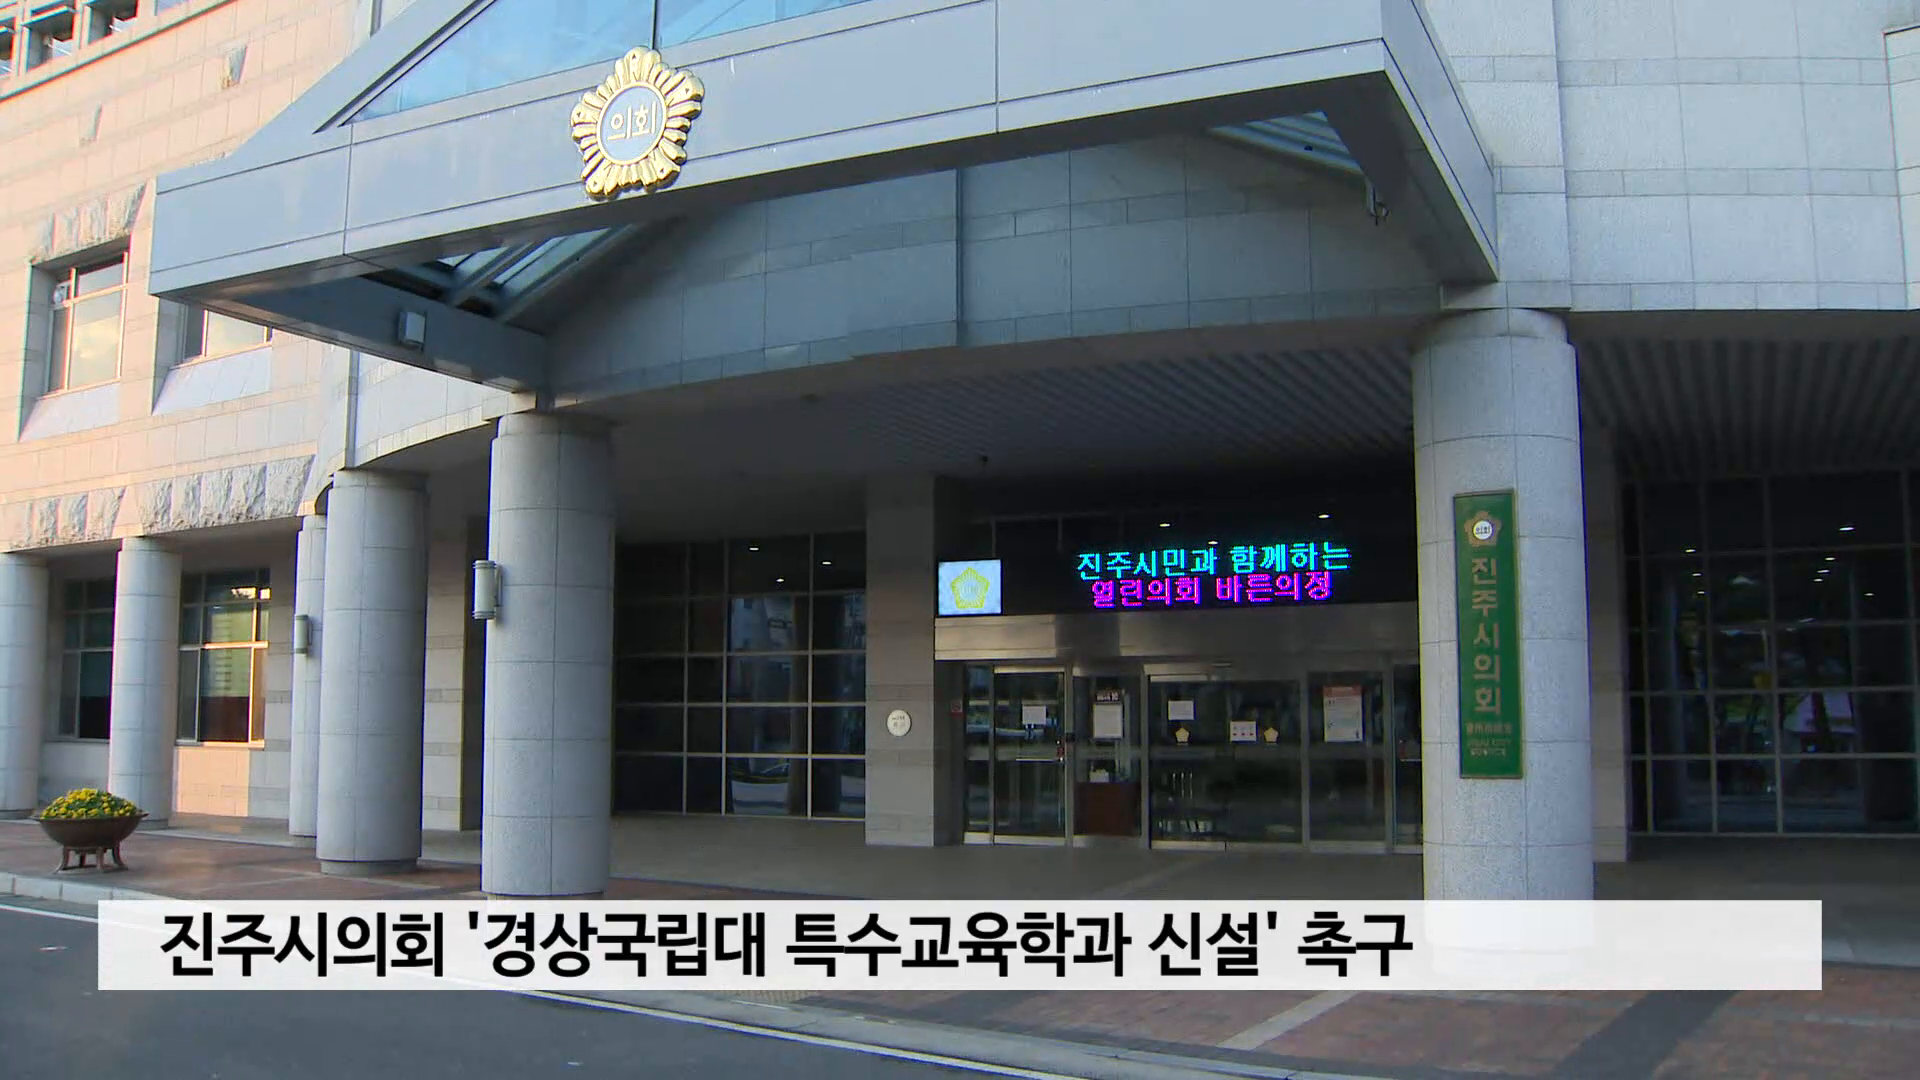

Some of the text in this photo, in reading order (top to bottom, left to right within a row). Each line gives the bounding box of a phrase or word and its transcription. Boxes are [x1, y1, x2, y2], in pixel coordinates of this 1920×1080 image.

[607, 101, 656, 140] 의회
[1077, 541, 1350, 580] 진주시민과 함께하는
[1091, 570, 1332, 608] 열린의회 바른의정
[1471, 557, 1501, 716] 진주시의회
